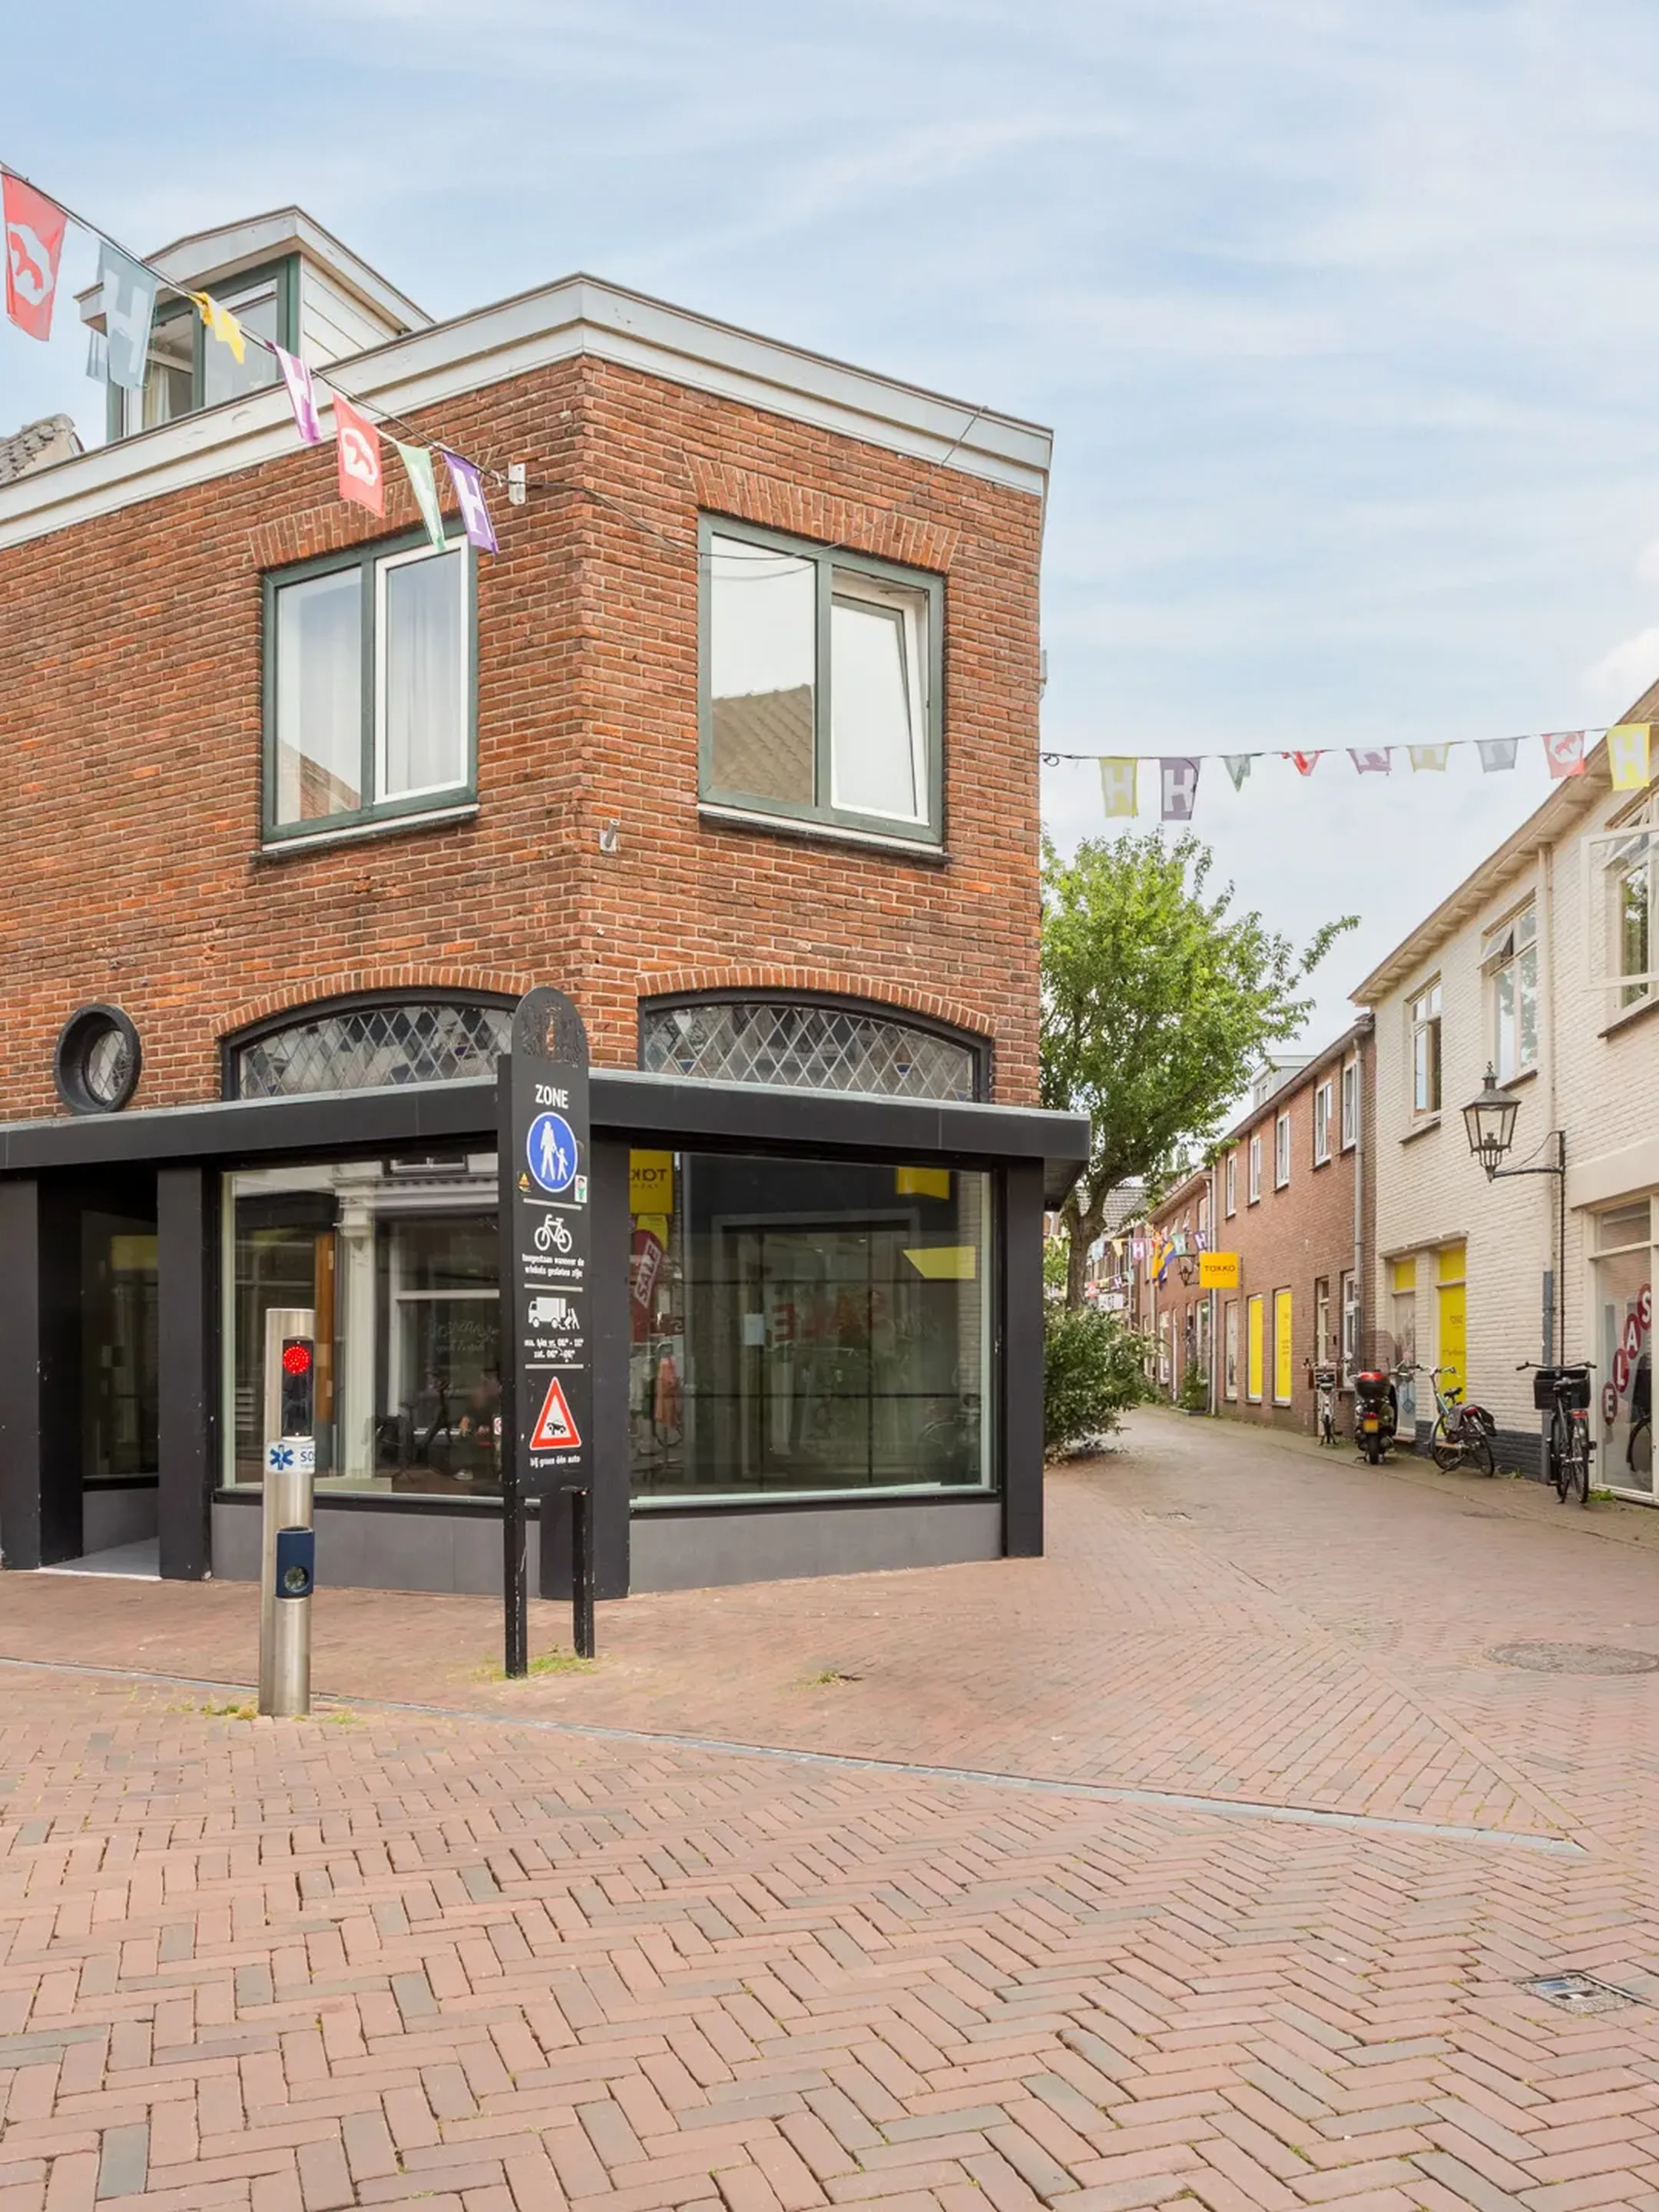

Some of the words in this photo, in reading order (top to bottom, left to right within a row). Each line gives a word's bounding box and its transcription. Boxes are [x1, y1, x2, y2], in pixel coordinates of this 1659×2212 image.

[1613, 730, 1647, 781] H
[535, 1084, 569, 1109] ZONE
[1605, 1290, 1651, 1417] SALE
[300, 1451, 314, 1462] SO
